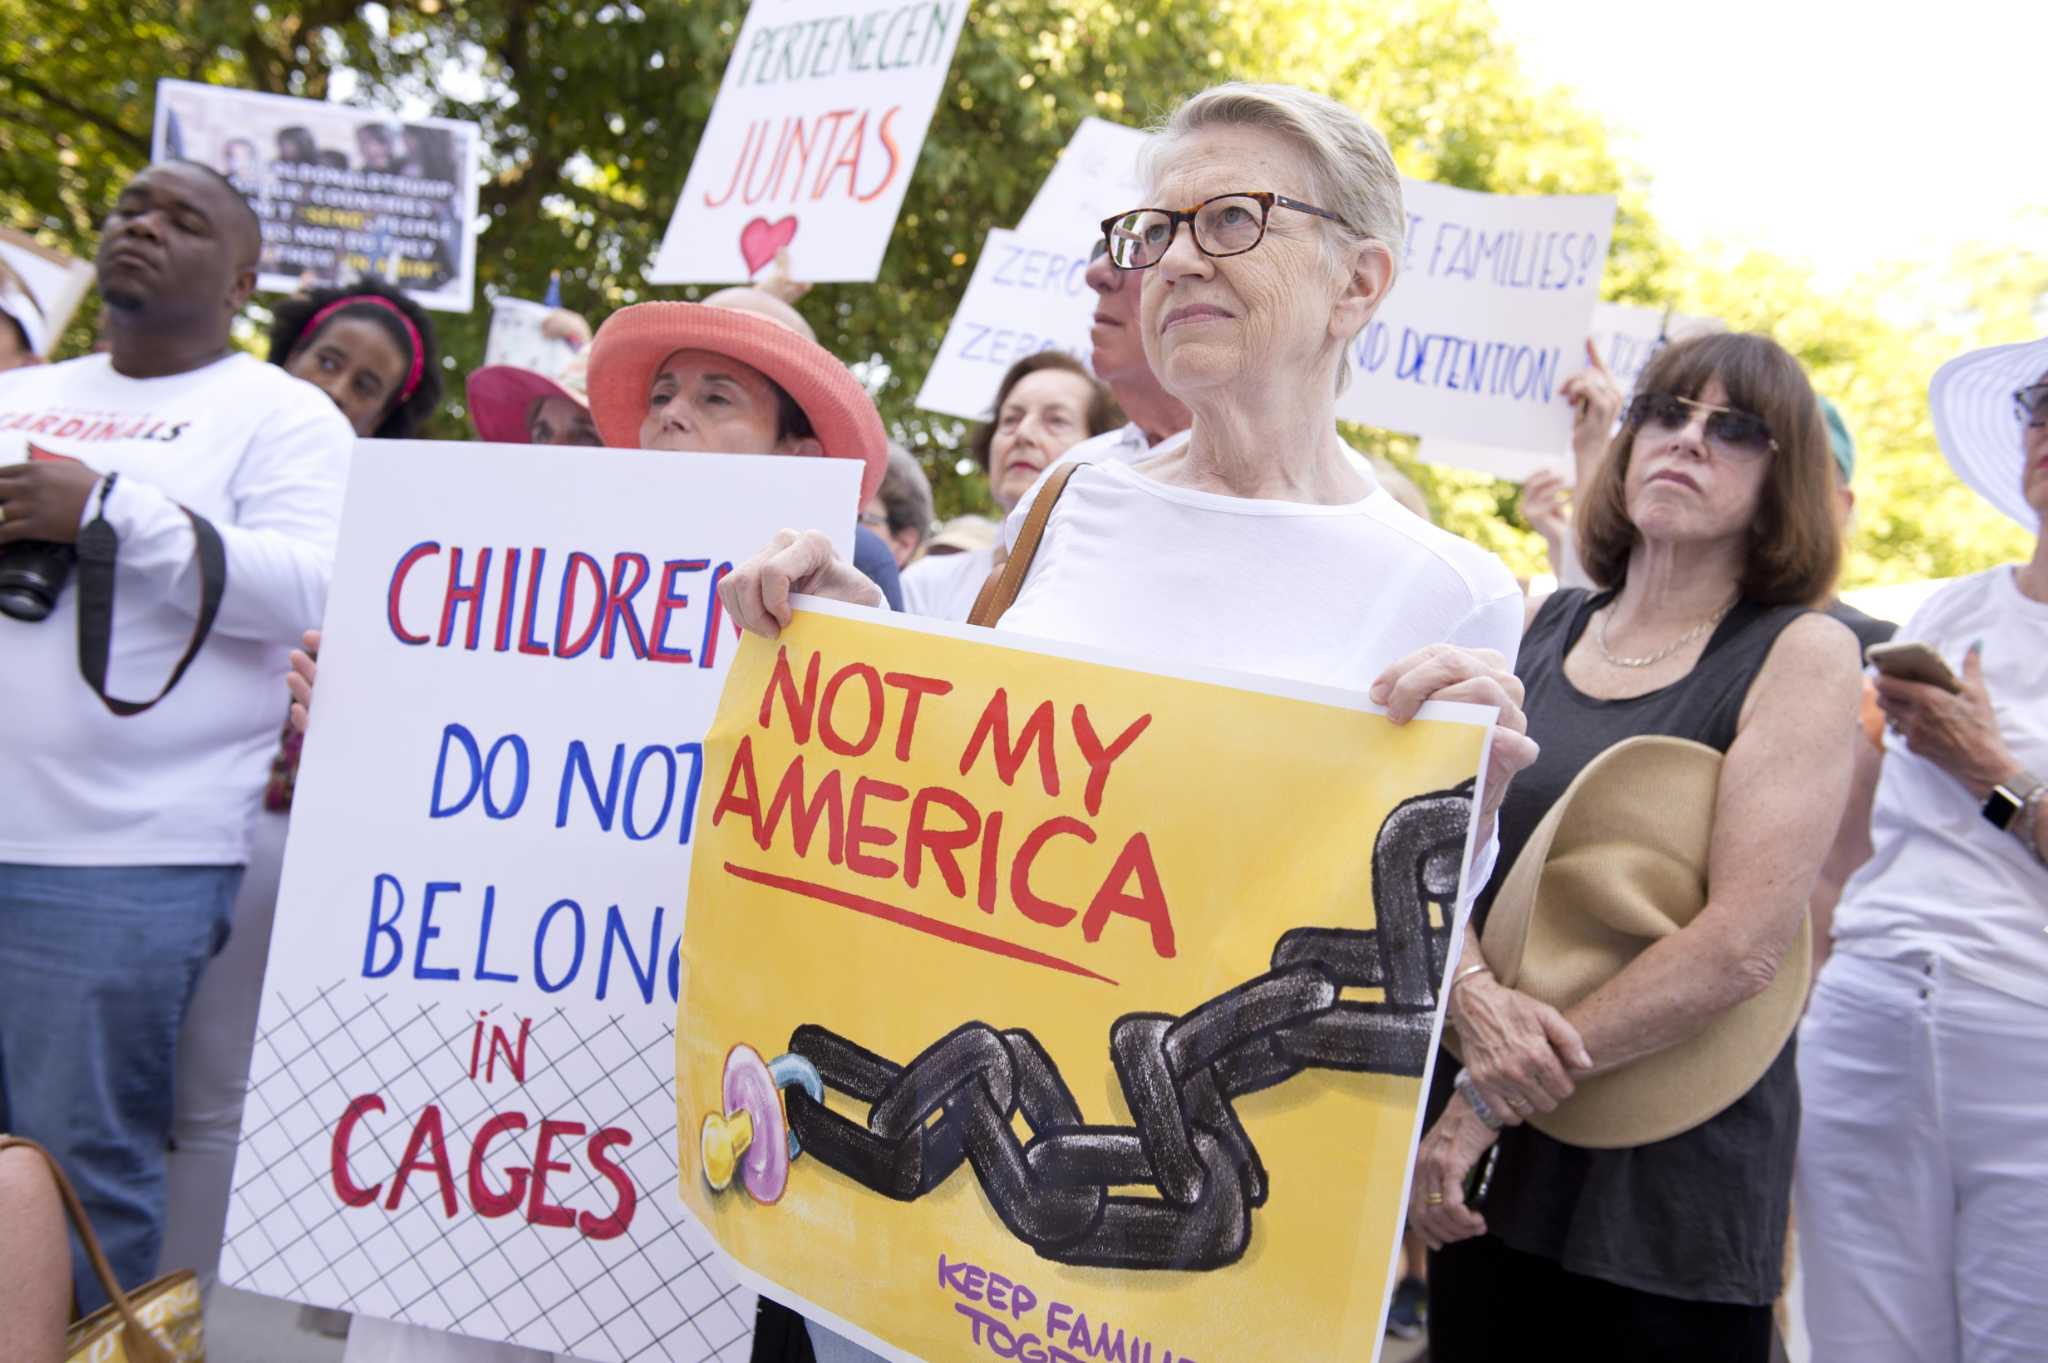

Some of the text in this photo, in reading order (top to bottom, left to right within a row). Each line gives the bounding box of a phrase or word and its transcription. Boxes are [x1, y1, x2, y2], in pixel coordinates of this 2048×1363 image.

[738, 1, 954, 87] PERTENECEN
[704, 105, 901, 208] JUNTAS
[992, 245, 1087, 296] ZERO
[958, 322, 1056, 366] ZER
[1395, 327, 1561, 403] DETENTION
[429, 723, 703, 845] DO NOT
[759, 644, 1152, 817] NOT MY
[712, 734, 1177, 959] AMERICA
[361, 872, 682, 1005] BELON
[331, 1093, 637, 1240] CAGES
[938, 1253, 1198, 1363] KEEP FAMI
